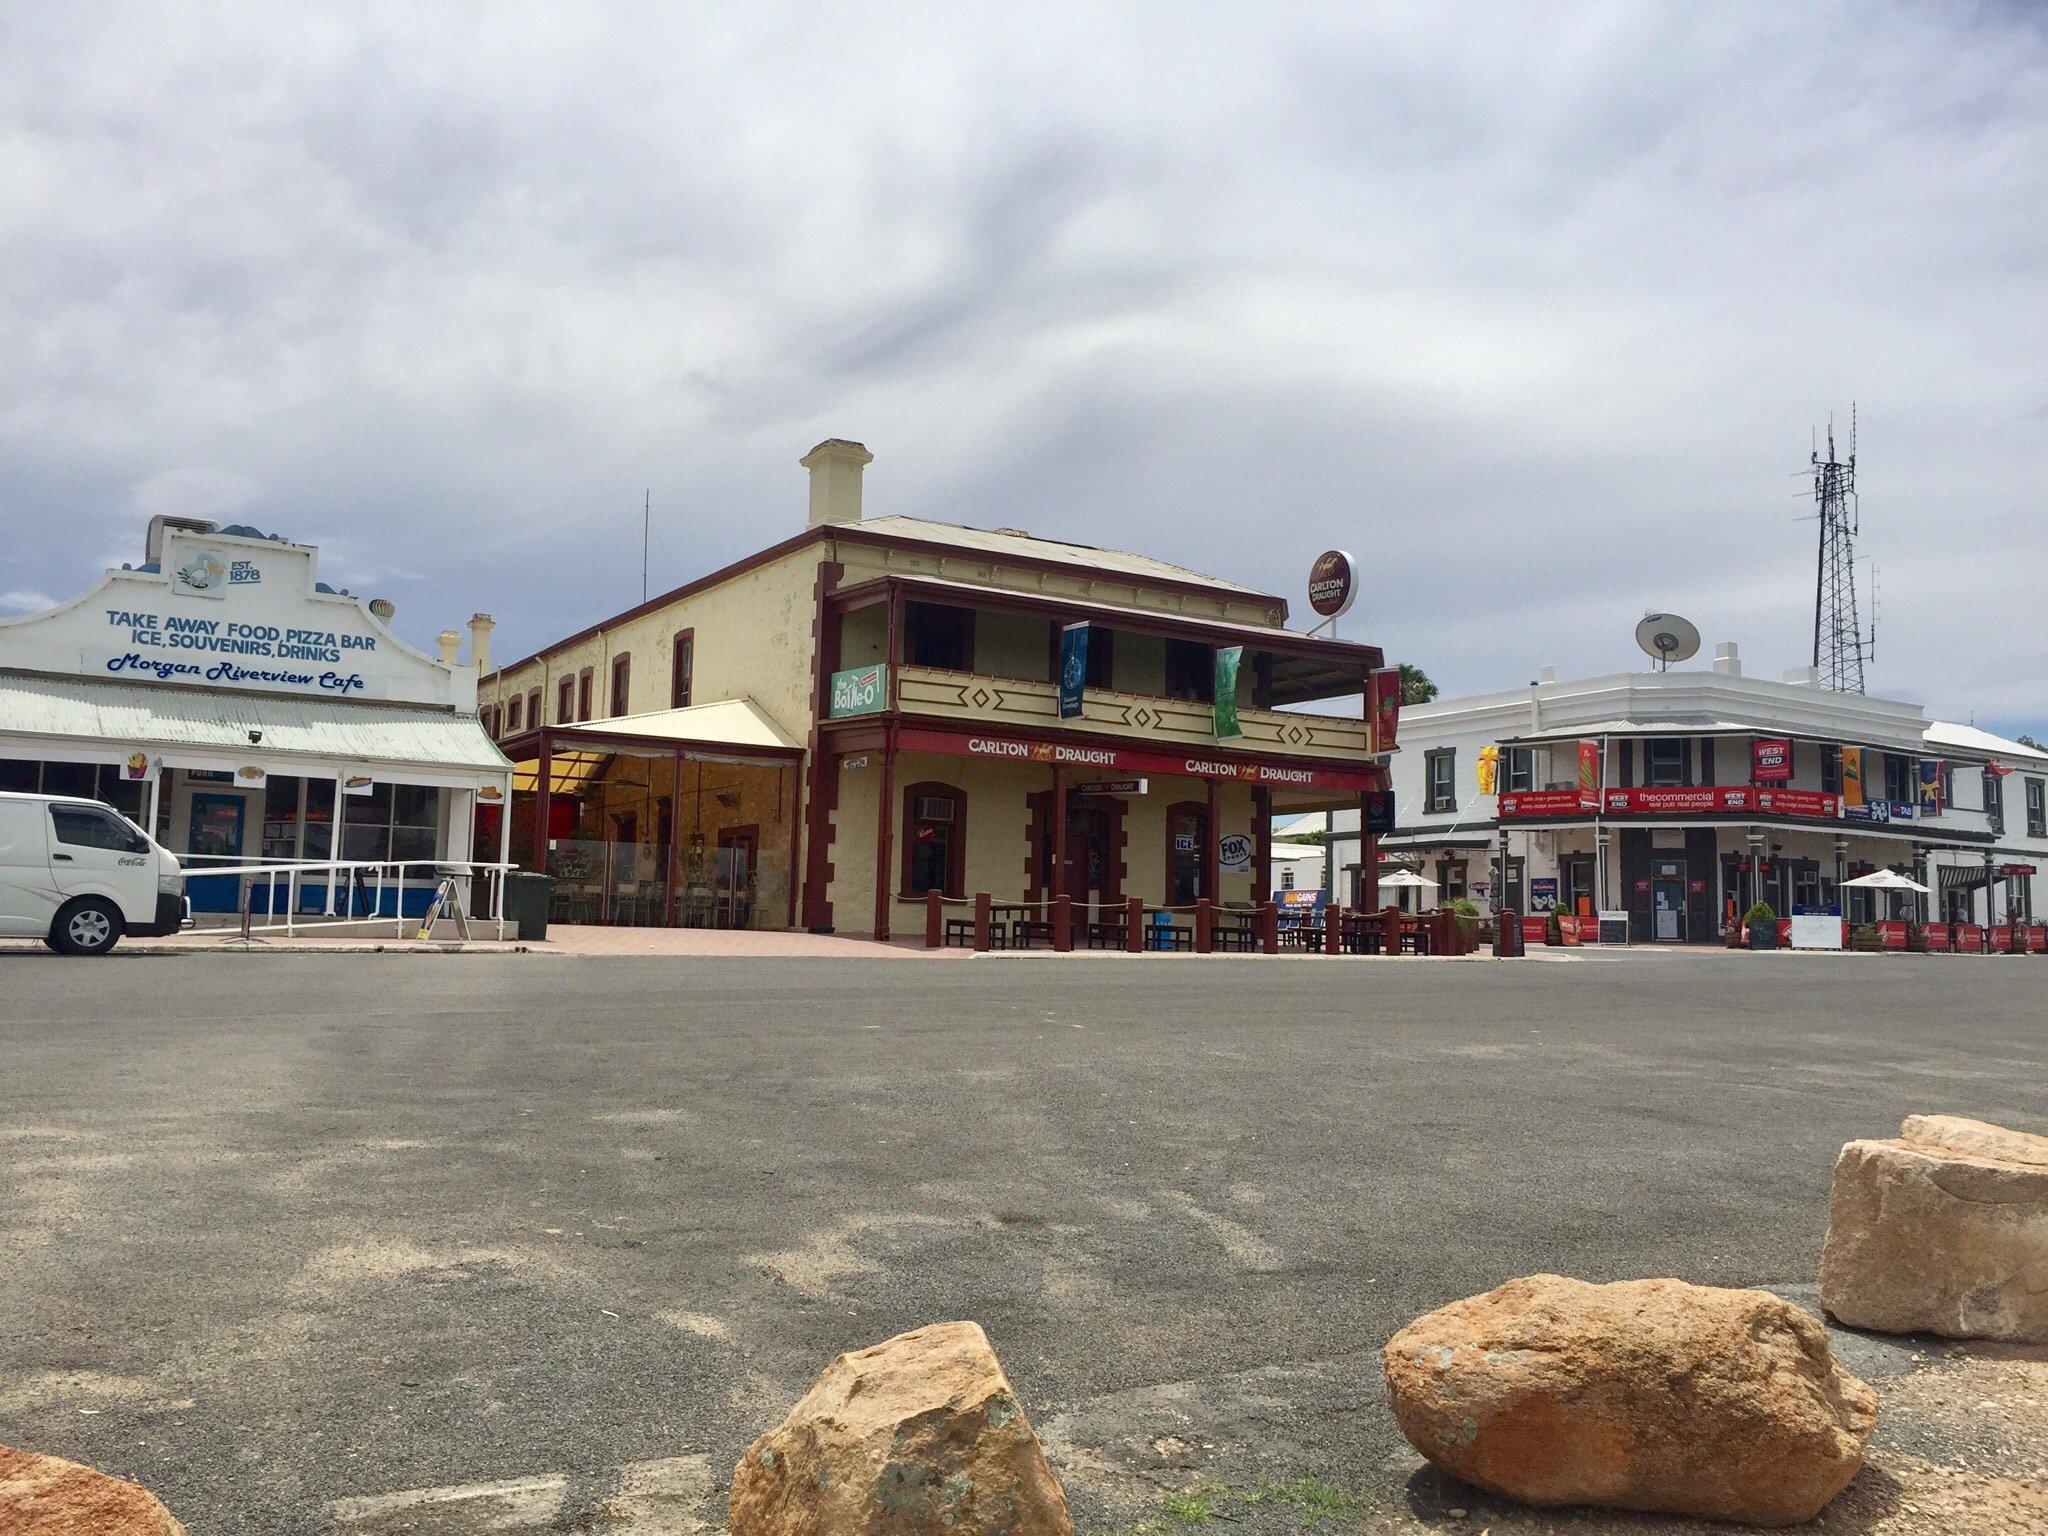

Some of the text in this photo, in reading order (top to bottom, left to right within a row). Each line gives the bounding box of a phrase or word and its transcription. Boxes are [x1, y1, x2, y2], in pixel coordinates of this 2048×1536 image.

[231, 560, 253, 570] EST.
[229, 569, 261, 582] 1878
[1310, 578, 1344, 593] CARLTON
[1312, 588, 1342, 601] DRAUGHT
[106, 610, 158, 630] TAKE
[164, 617, 220, 635] AWAY
[286, 629, 336, 647] PIZZA
[341, 634, 376, 651] BAR
[277, 644, 341, 663] DRINKS
[107, 652, 364, 693] Morgan Riverview Cafe
[968, 738, 1117, 765] CARLTON DRAUGHT
[1759, 747, 1785, 757] WEST
[1761, 756, 1783, 765] END
[1185, 759, 1313, 783] CARLTON DRAUGHT
[1640, 792, 1714, 802] thecommercial
[1176, 838, 1193, 849] ICE
[1221, 839, 1247, 858] FOX
[1284, 892, 1318, 903] BARGAINS
